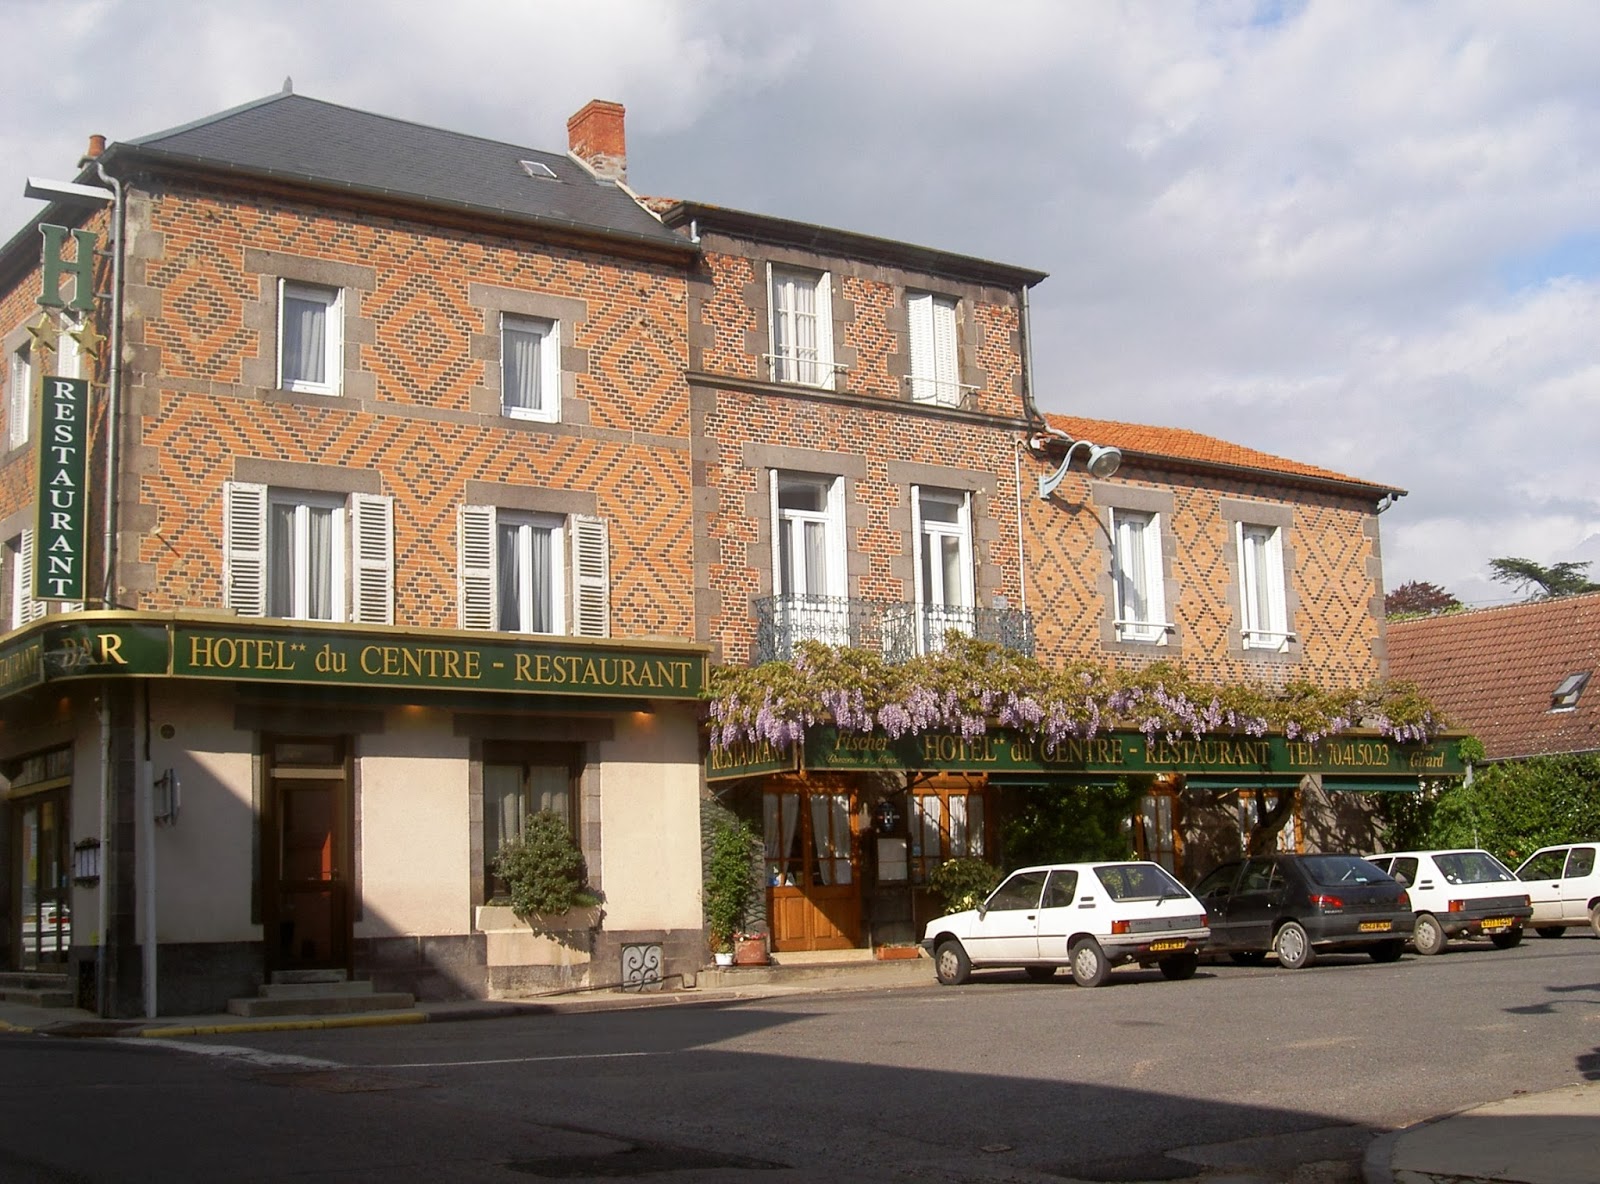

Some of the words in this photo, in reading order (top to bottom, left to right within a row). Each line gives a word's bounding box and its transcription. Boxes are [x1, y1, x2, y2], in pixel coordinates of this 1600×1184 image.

[48, 381, 76, 596] RESTAURANT
[60, 633, 128, 668] BAR
[314, 643, 347, 673] du
[360, 645, 482, 680] CENTRE
[514, 653, 693, 689] RESTAURANT
[1010, 740, 1033, 762] du
[1040, 738, 1124, 764] CENTRE
[1144, 740, 1270, 765] RESTAURANT
[1326, 743, 1389, 766] 70.41.50.23
[1410, 751, 1445, 768] Girard
